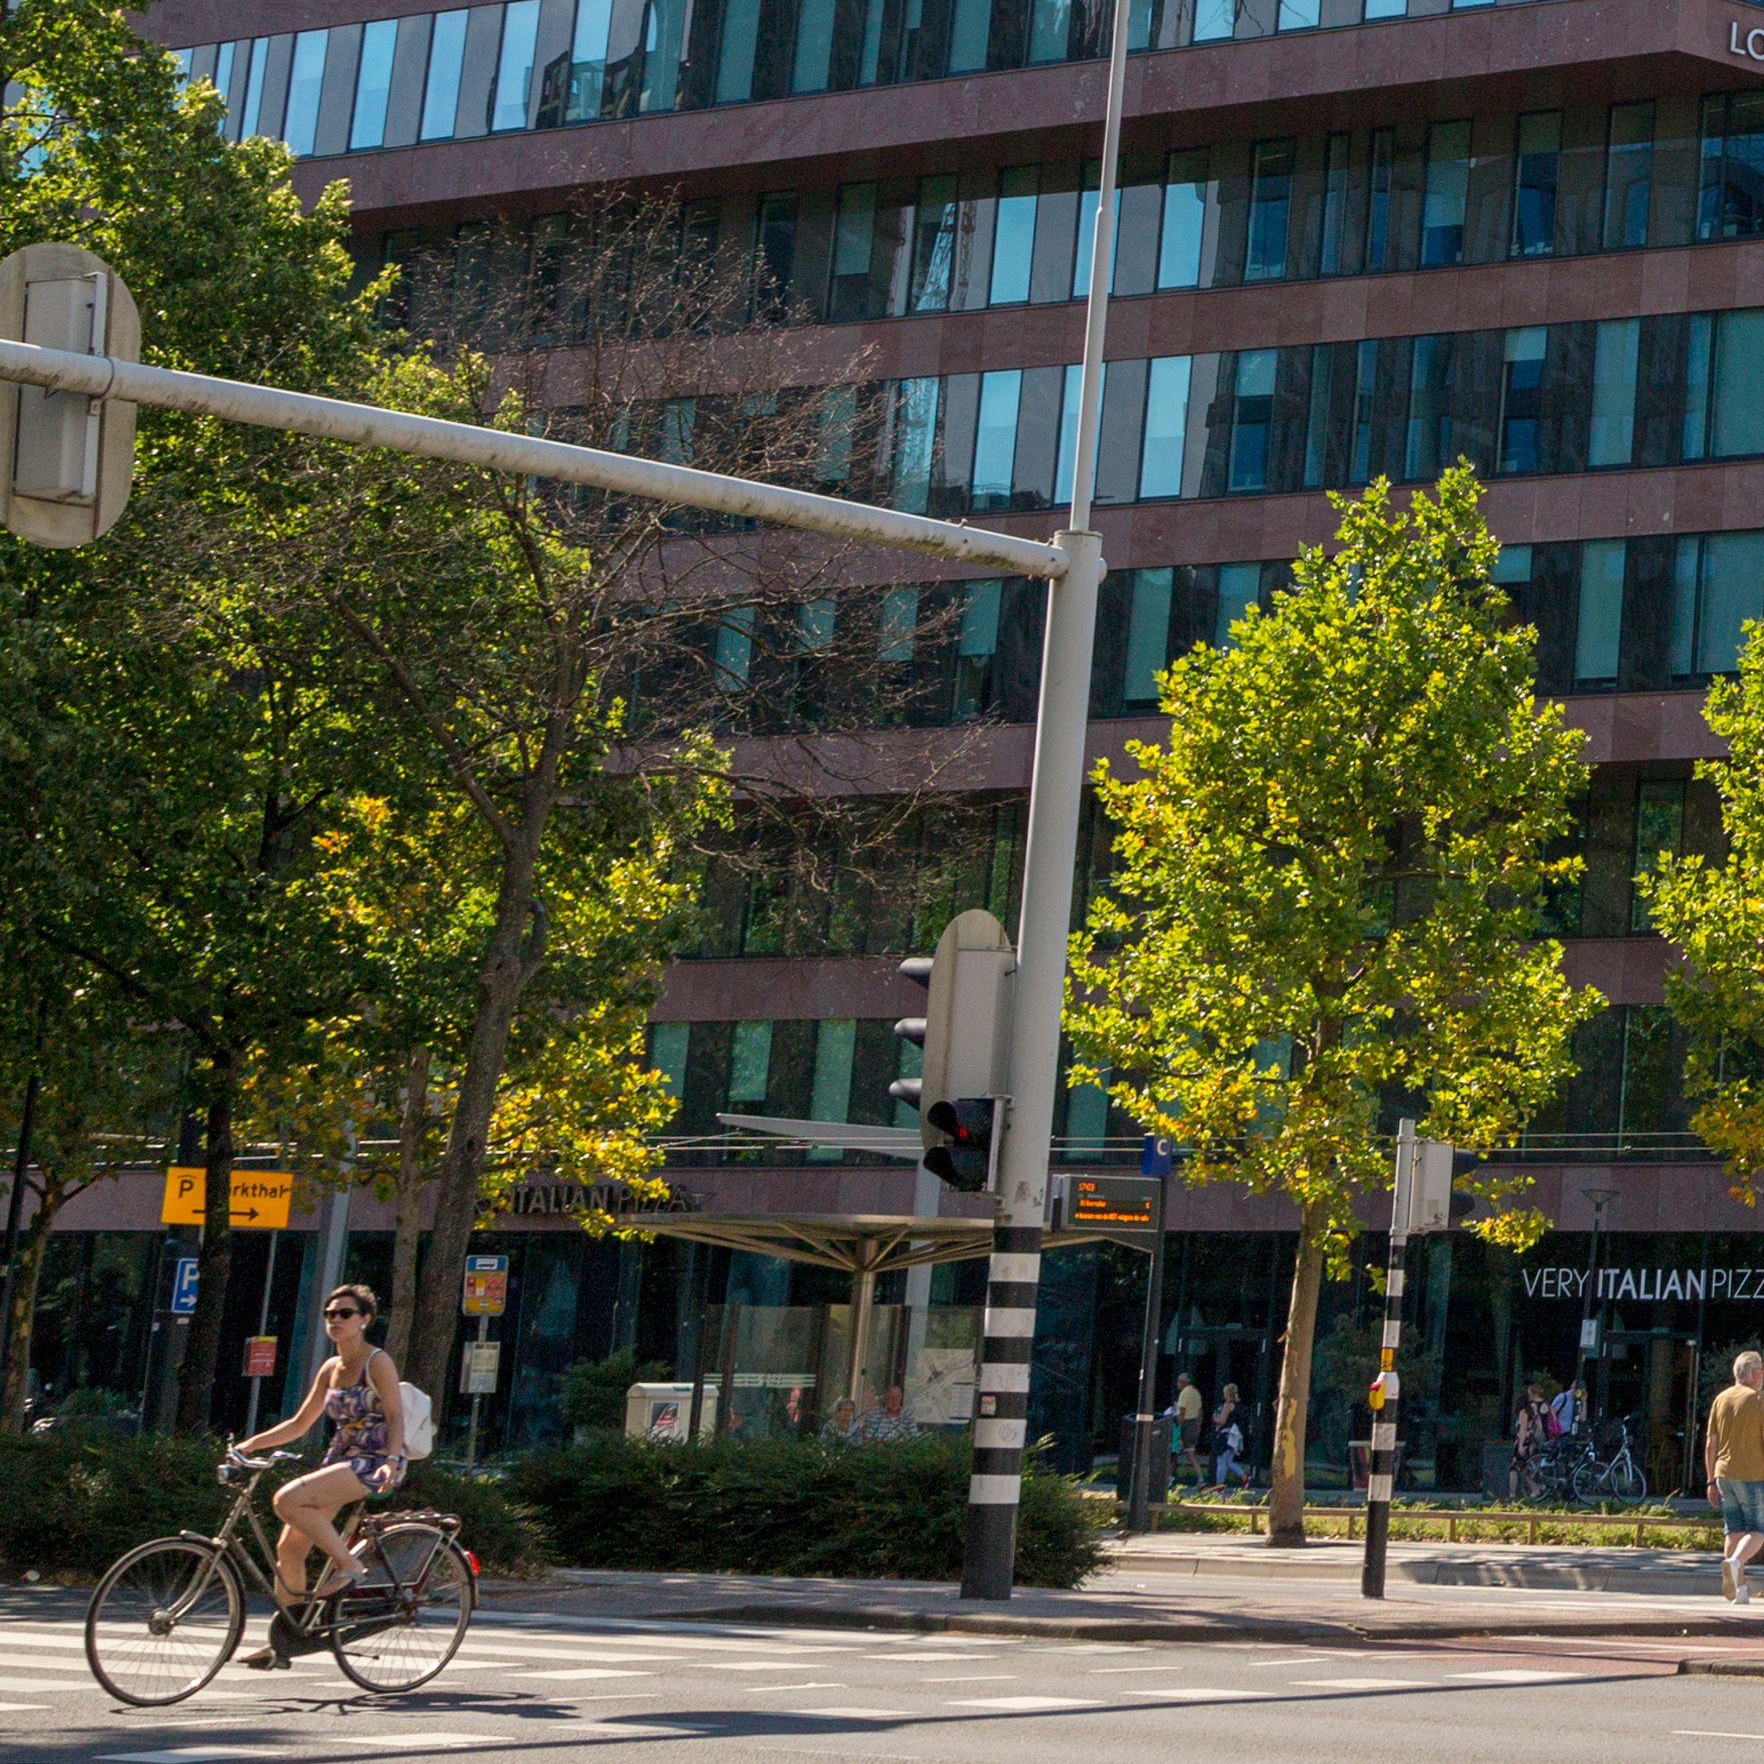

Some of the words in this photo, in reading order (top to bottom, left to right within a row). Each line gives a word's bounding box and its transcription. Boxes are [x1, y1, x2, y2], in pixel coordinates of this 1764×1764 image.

[1156, 1138, 1168, 1156] C
[178, 1179, 194, 1199] P
[229, 1182, 285, 1199] rkthal
[181, 1262, 200, 1291] P
[1521, 1267, 1591, 1298] VERY
[1597, 1267, 1707, 1300] ITALIAN
